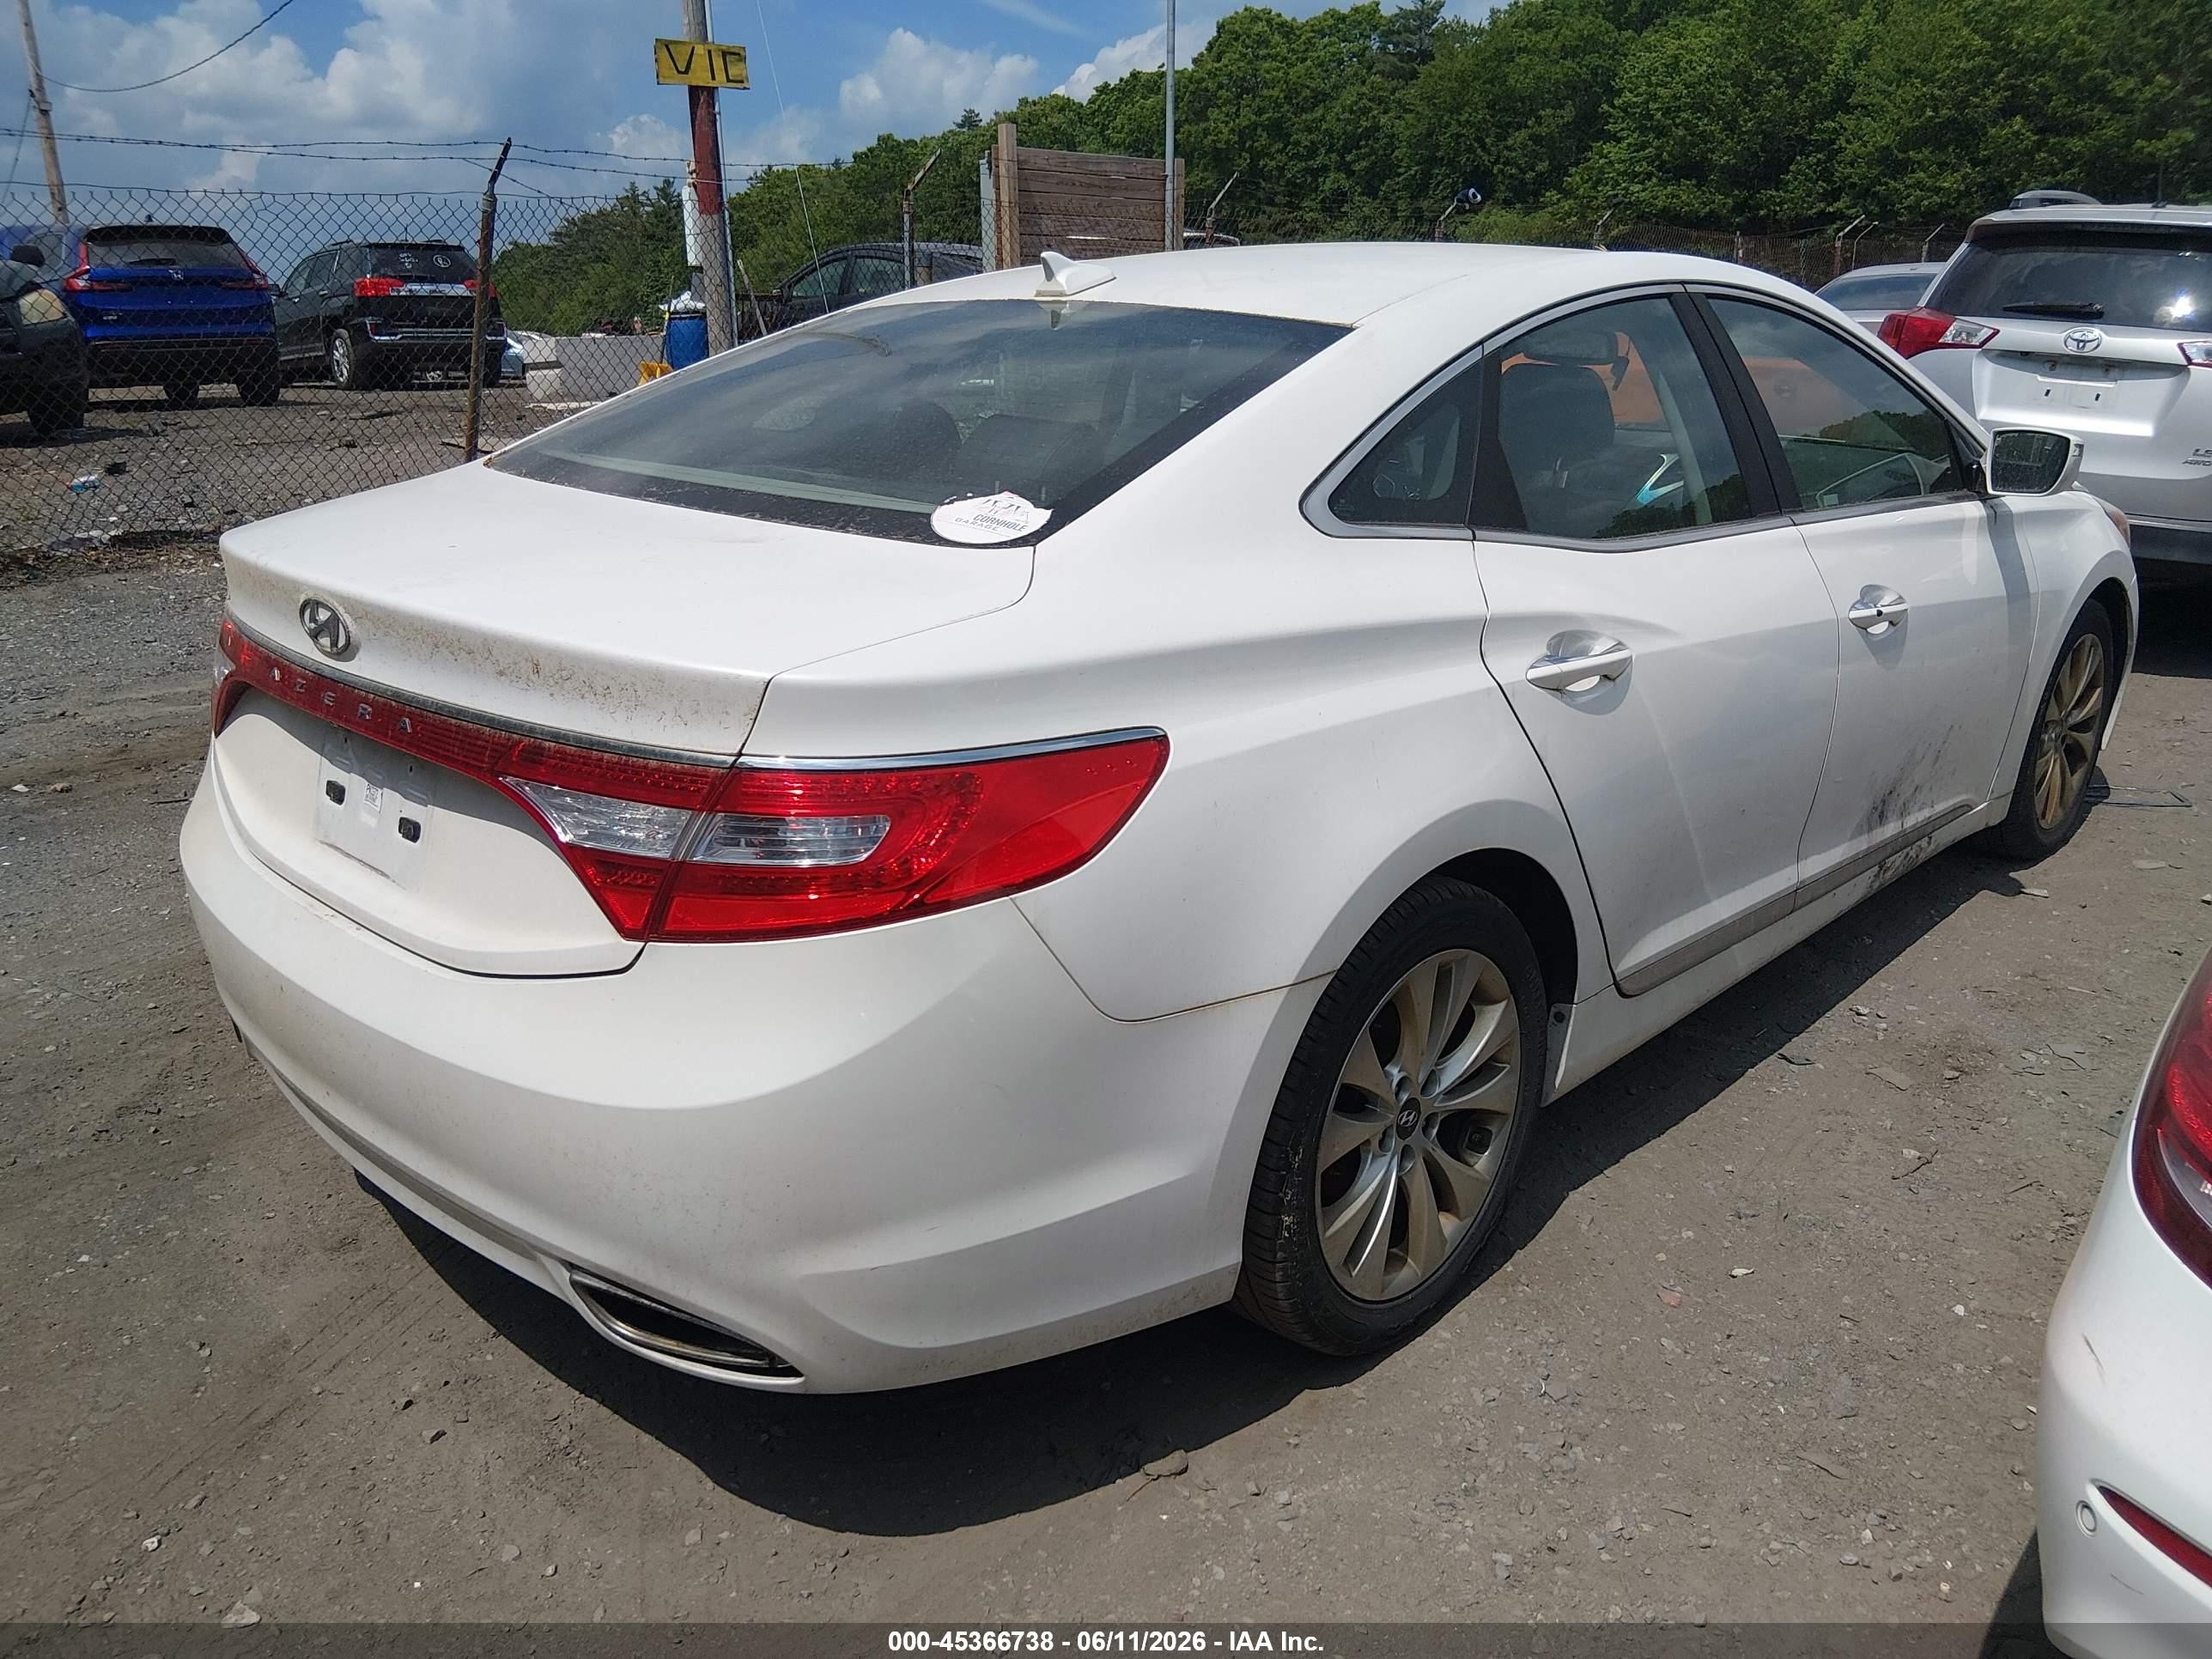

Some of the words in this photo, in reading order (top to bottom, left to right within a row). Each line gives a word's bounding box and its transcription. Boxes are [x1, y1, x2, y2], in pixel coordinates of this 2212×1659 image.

[955, 517, 1001, 532] GARAGE
[973, 514, 1030, 532] CORNHOLE
[269, 666, 412, 734] AZERA
